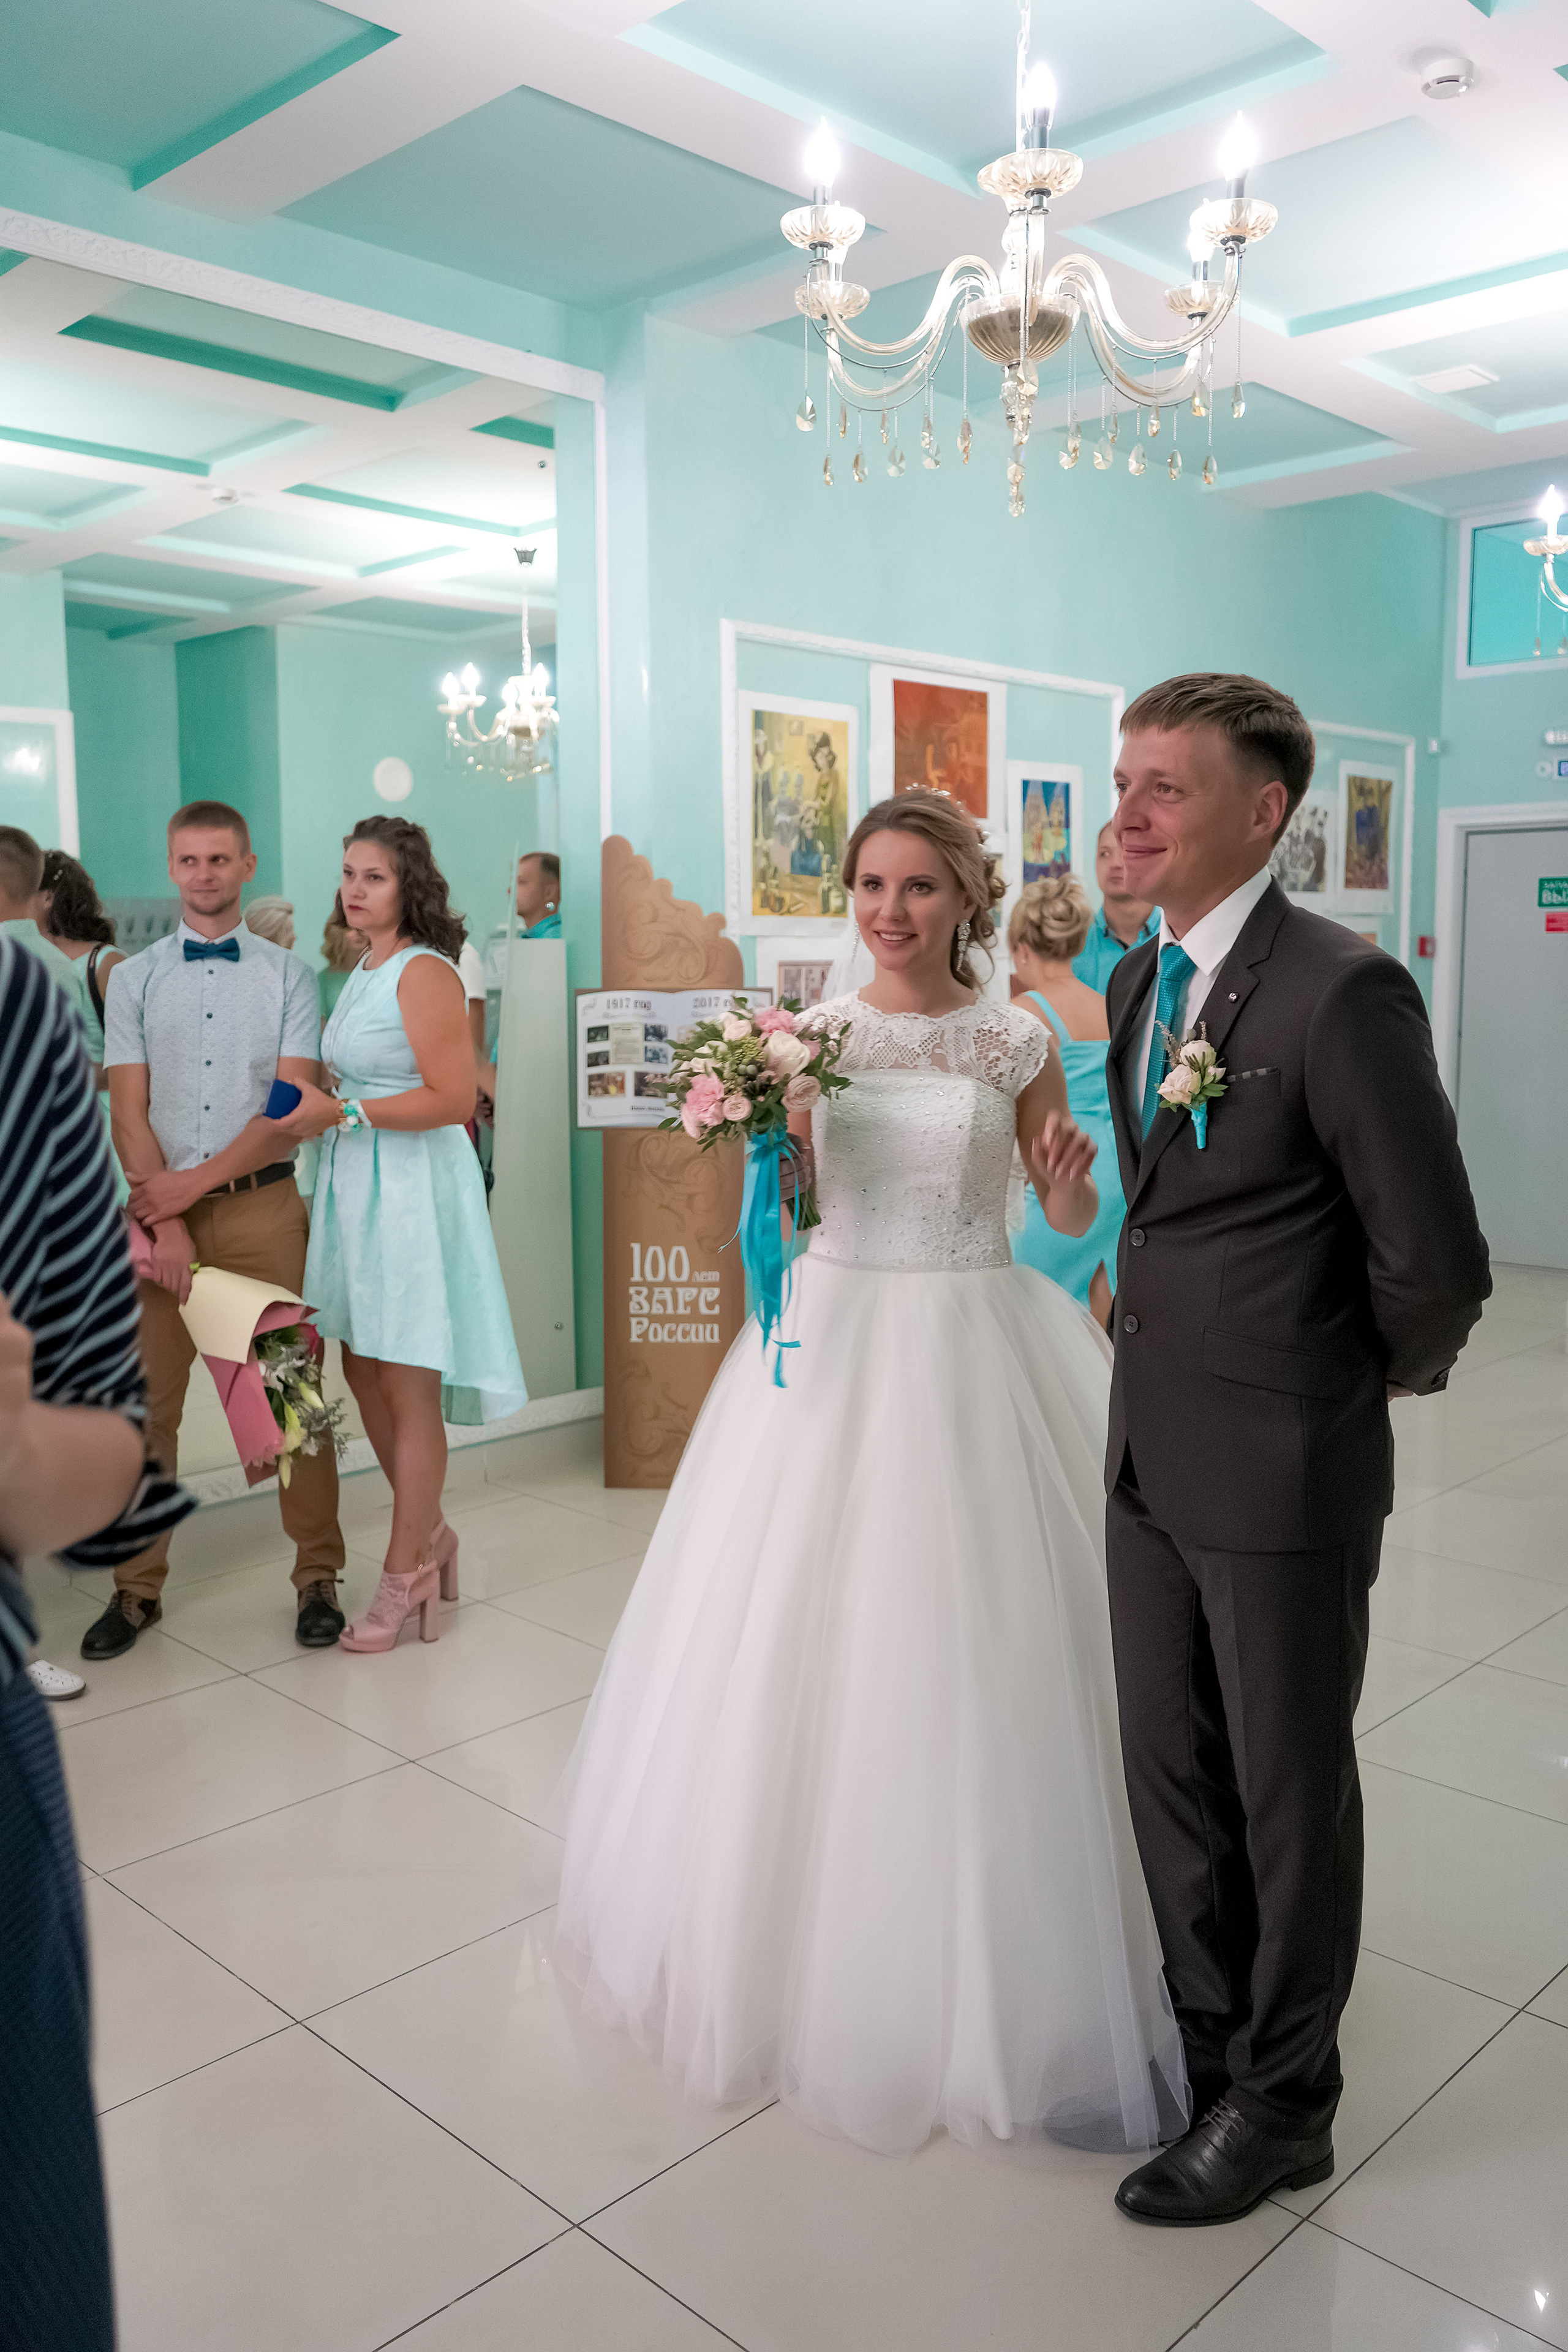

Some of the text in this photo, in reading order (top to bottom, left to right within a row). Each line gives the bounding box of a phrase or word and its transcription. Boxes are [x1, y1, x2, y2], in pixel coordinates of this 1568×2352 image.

[606, 998, 631, 1009] 1917
[693, 997, 720, 1008] 2017
[630, 1242, 690, 1283] 100
[628, 1286, 720, 1315] ЗАГС
[630, 1317, 720, 1343] России
